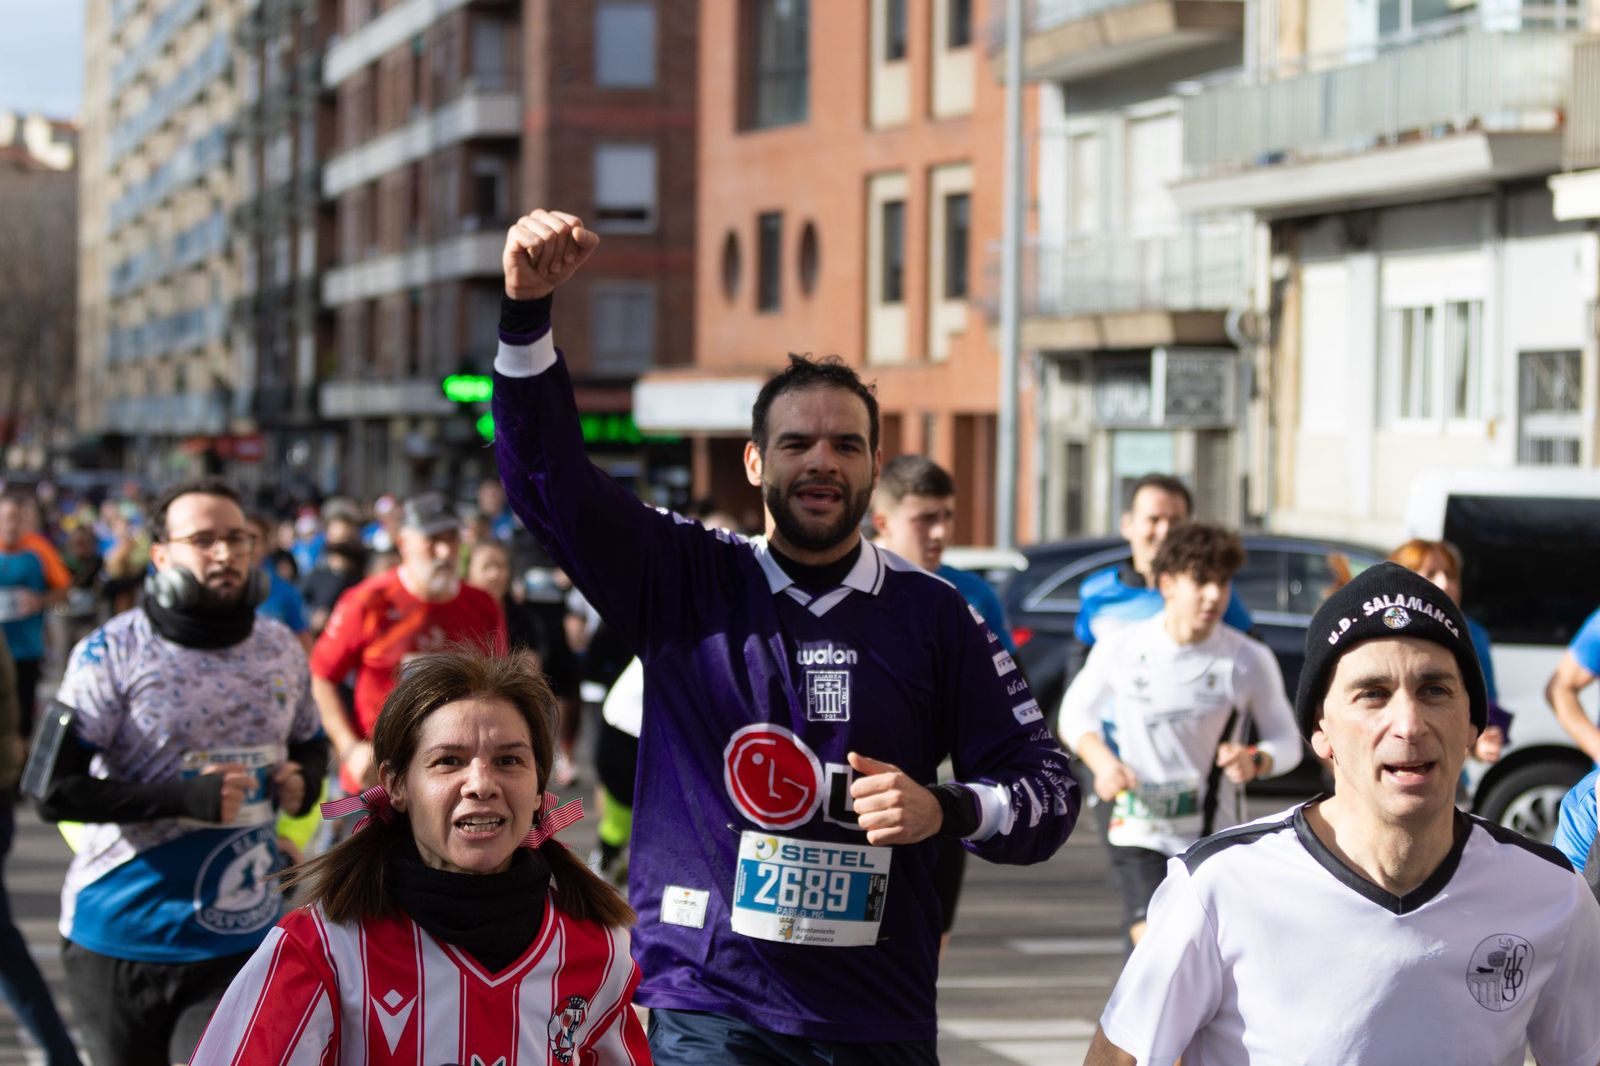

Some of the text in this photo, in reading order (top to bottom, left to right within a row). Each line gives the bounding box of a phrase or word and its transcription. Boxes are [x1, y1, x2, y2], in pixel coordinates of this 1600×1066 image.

[1362, 594, 1460, 638] SALAMANCA
[797, 643, 858, 665] walon
[780, 844, 875, 868] SETEL
[754, 863, 851, 912] 2689
[804, 934, 834, 943] Salamanca
